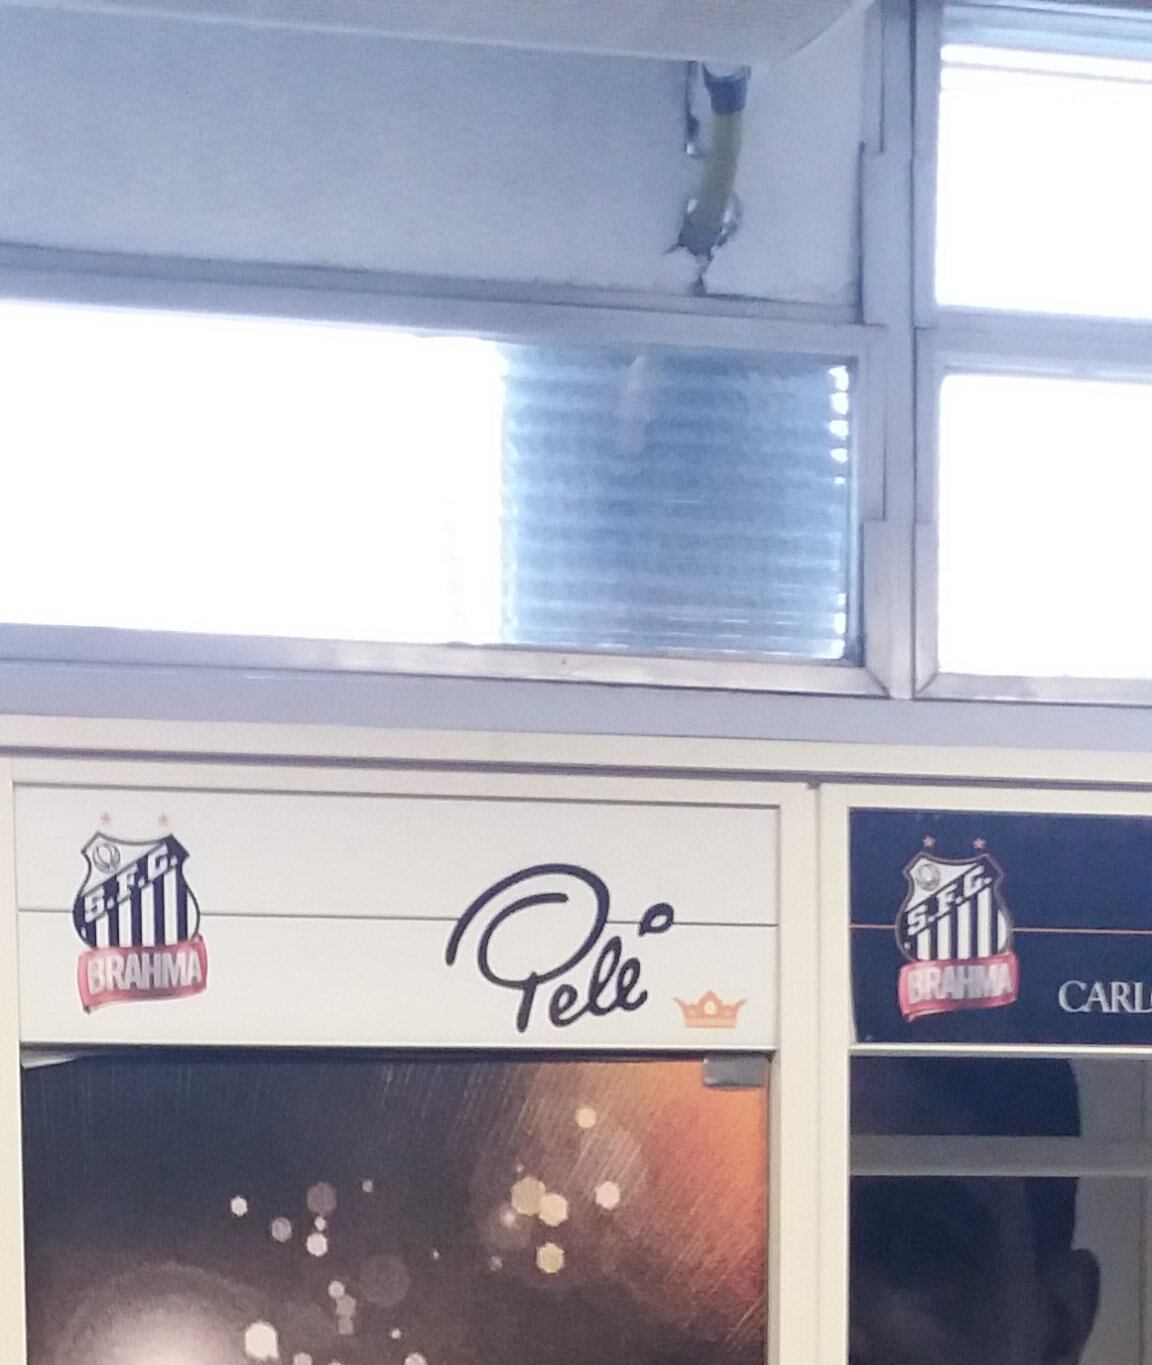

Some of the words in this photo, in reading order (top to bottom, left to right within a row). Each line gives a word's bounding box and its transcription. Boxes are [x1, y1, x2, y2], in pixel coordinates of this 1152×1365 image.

[445, 863, 675, 1033] Pelé
[87, 950, 202, 995] BRAHMA
[908, 961, 1013, 1005] BRAHMA
[1058, 979, 1152, 1014] CARL
